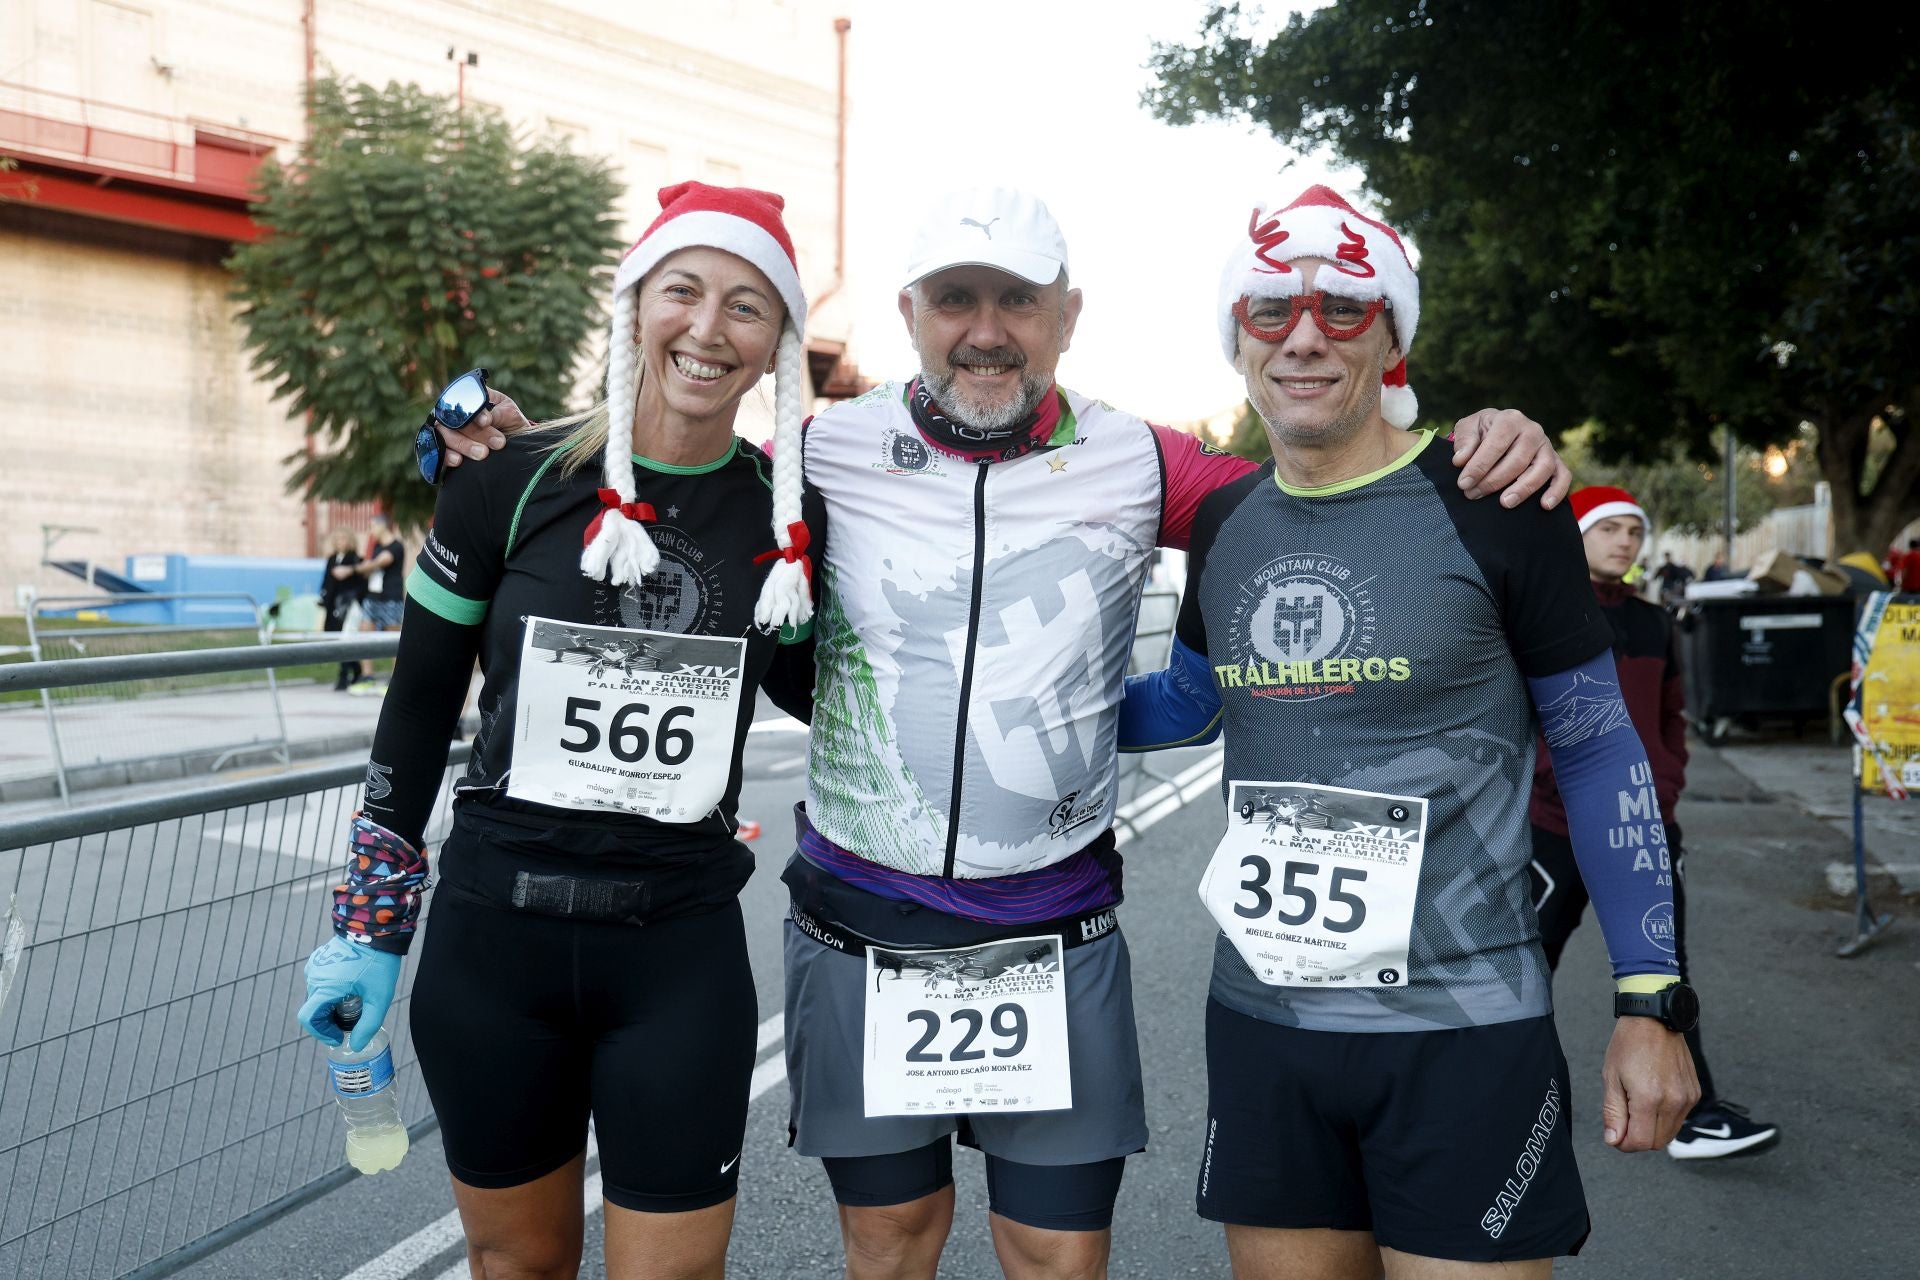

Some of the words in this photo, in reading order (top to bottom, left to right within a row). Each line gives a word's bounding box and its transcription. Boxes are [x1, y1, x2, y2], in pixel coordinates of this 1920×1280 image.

[676, 538, 704, 563] CLUB
[1253, 558, 1315, 588] MOUNTAIN
[1317, 559, 1351, 581] CLUB
[1355, 589, 1376, 654] EXTREME
[661, 674, 731, 686] CARRERA
[672, 663, 738, 678] XIV
[1214, 656, 1412, 688] TRALHILEROS
[587, 681, 643, 691] PALMA
[651, 686, 729, 698] PALMILLA
[622, 677, 650, 686] SAN
[655, 680, 730, 692] SILVESTRE
[1294, 686, 1306, 695] DE
[1308, 685, 1320, 694] LA
[1324, 684, 1355, 693] TORRE
[560, 696, 695, 766] 566
[568, 759, 617, 775] GUADALUPE
[618, 769, 652, 780] MONROY
[1333, 833, 1410, 850] CARRERA
[1347, 821, 1418, 841] XIV
[1609, 825, 1643, 849] UN
[1261, 838, 1314, 850] PALMA
[1322, 846, 1408, 863] PALMILLA
[1291, 835, 1321, 844] SAN
[1328, 839, 1409, 856] SILVESTRE
[1633, 849, 1654, 872] A
[1233, 854, 1367, 933] 355
[1245, 927, 1274, 939] MIGUEL
[1275, 931, 1302, 943] GÓMEZ
[1304, 937, 1347, 950] MARTINEZ
[989, 974, 1053, 984] CARRERA
[1001, 962, 1058, 976] XIV
[981, 985, 1054, 996] PALMILLA
[984, 979, 1054, 990] SILVESTRE
[905, 1003, 1028, 1063] 229
[927, 1069, 959, 1077] ANTONIO
[961, 1065, 990, 1075] ESCAÑO
[991, 1063, 1033, 1072] MONTAÑEZ
[1202, 1118, 1217, 1197] SALOMON
[1480, 1078, 1560, 1239] SALOMON
